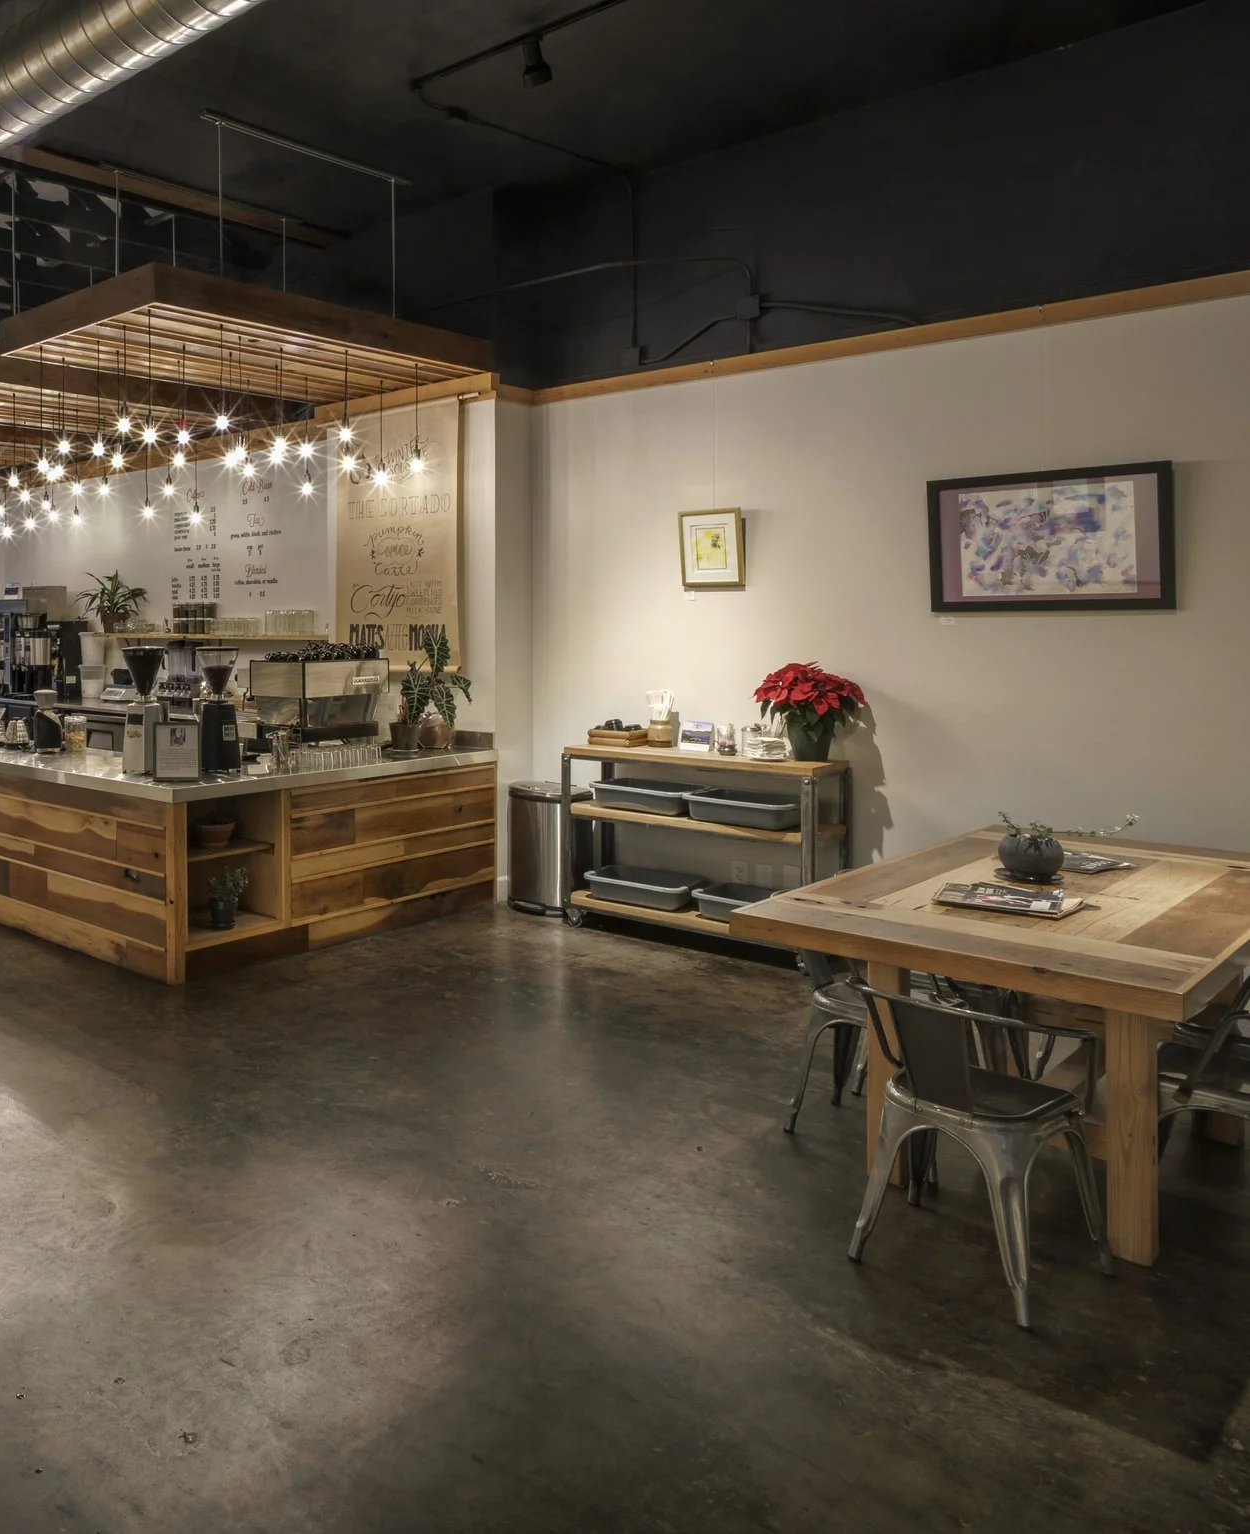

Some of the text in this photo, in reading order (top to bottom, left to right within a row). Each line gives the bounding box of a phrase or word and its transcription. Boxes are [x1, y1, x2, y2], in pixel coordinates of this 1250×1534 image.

[348, 493, 451, 520] THE CORTADO
[364, 525, 424, 548] pumpkin
[385, 624, 408, 651] AZTEC
